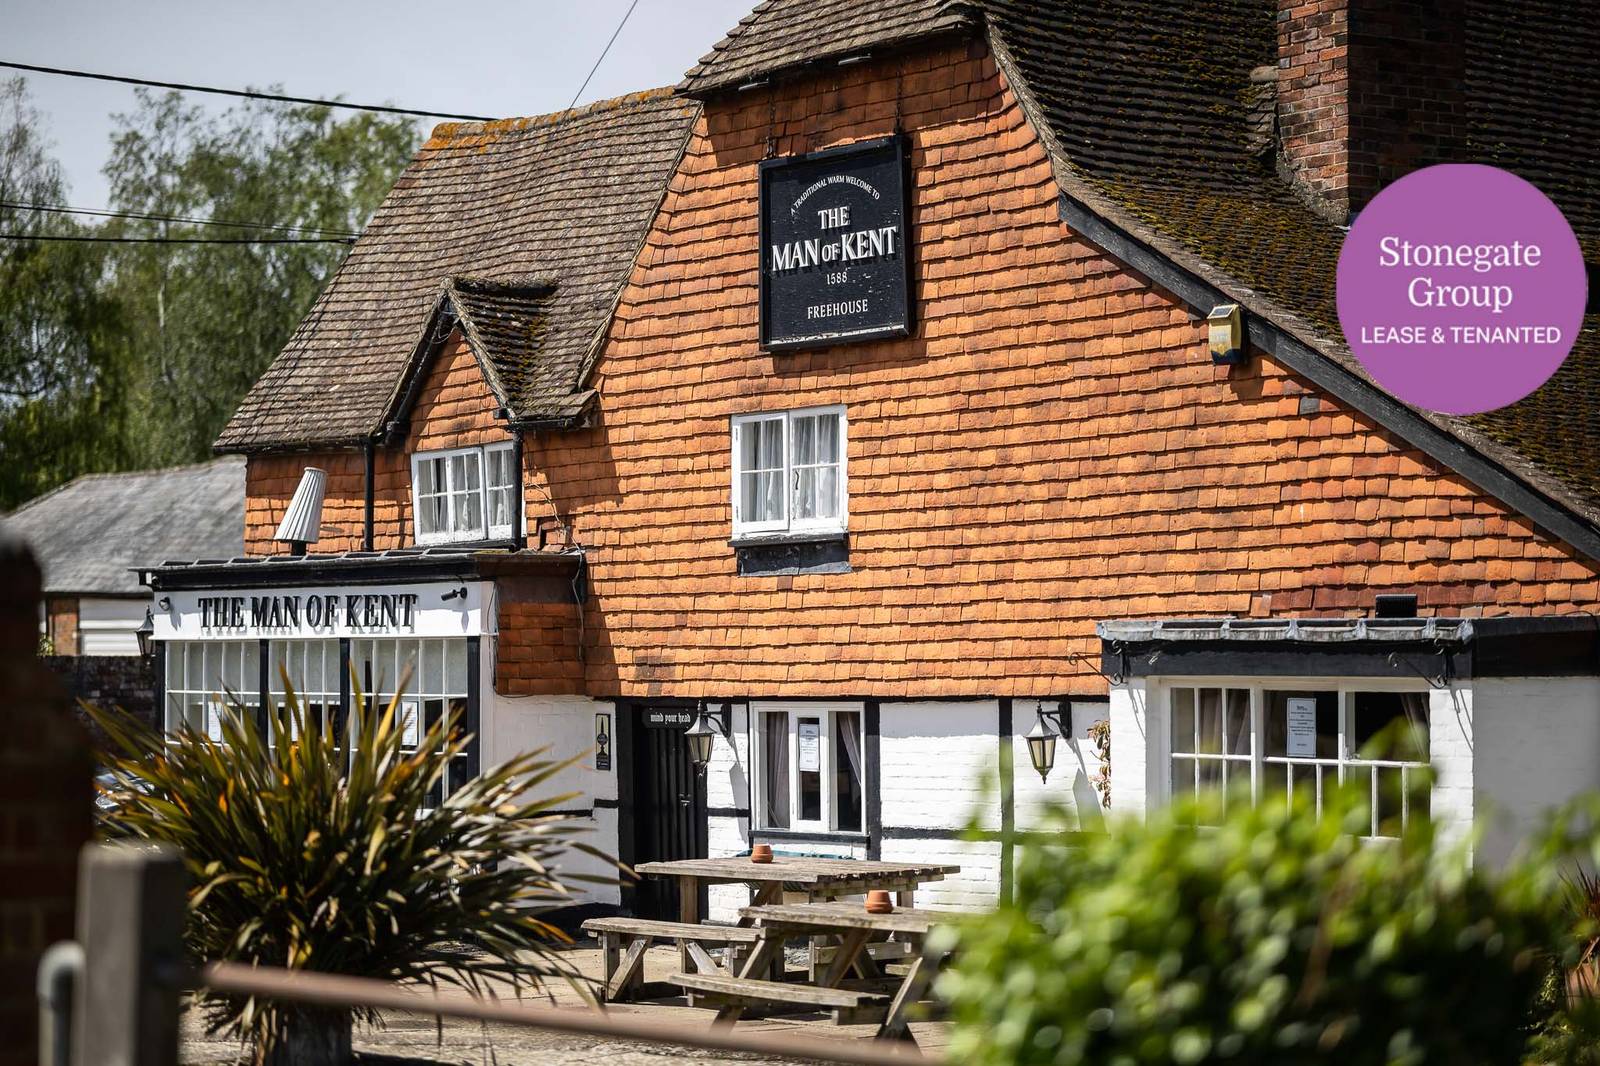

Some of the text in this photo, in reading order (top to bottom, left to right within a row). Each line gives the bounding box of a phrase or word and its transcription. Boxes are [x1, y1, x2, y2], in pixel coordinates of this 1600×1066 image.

[793, 180, 827, 209] TRADITIONAL
[827, 175, 845, 184] WARM
[845, 175, 873, 193] WELCOME
[871, 189, 880, 200] TO
[818, 206, 850, 230] THE
[772, 226, 898, 271] MAN OF KENT
[826, 271, 848, 285] 1588
[807, 299, 869, 319] FREEHOUSE
[198, 594, 418, 629] THE MAN OF KENT
[650, 712, 691, 725] mind your head
